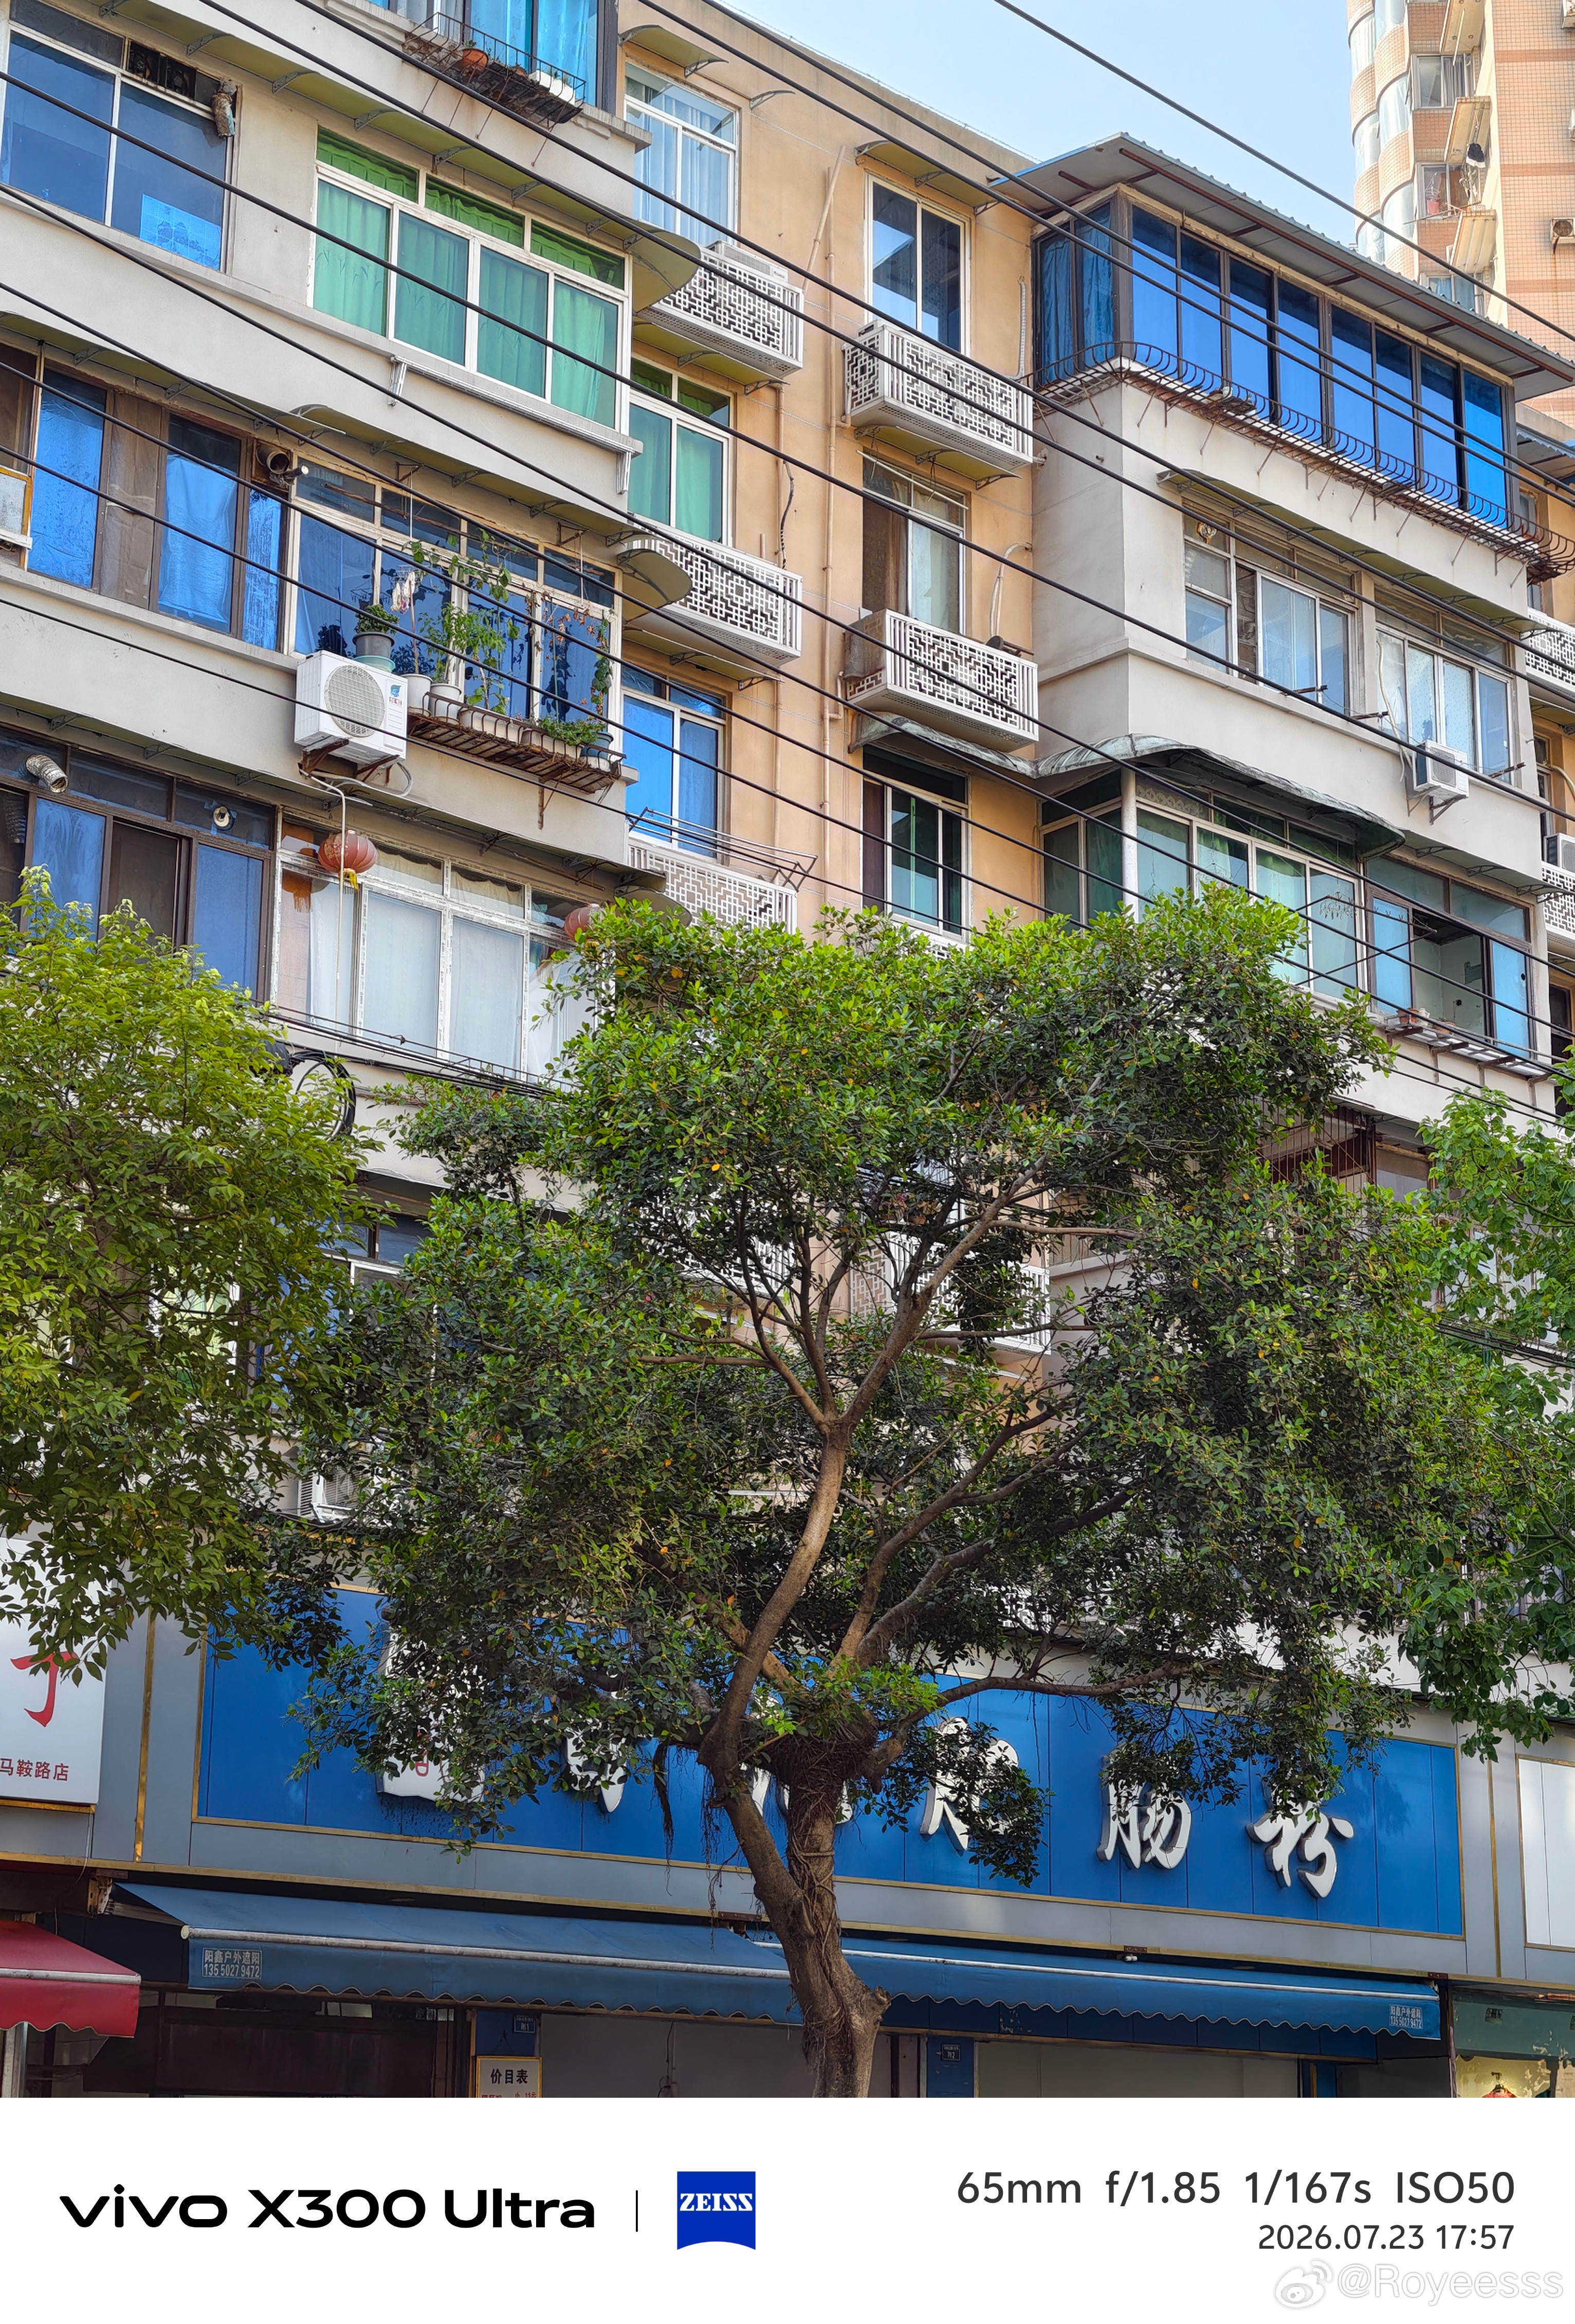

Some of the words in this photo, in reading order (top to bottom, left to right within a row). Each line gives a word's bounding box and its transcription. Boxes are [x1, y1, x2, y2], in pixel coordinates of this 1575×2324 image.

[0, 1758, 69, 1782] 马鞍路店
[205, 1949, 260, 1965] 阳鑫户外遮阳
[204, 1964, 219, 1975] 135
[221, 1964, 239, 1976] 5027
[241, 1965, 260, 1977] 9472
[490, 2068, 528, 2084] 价目表
